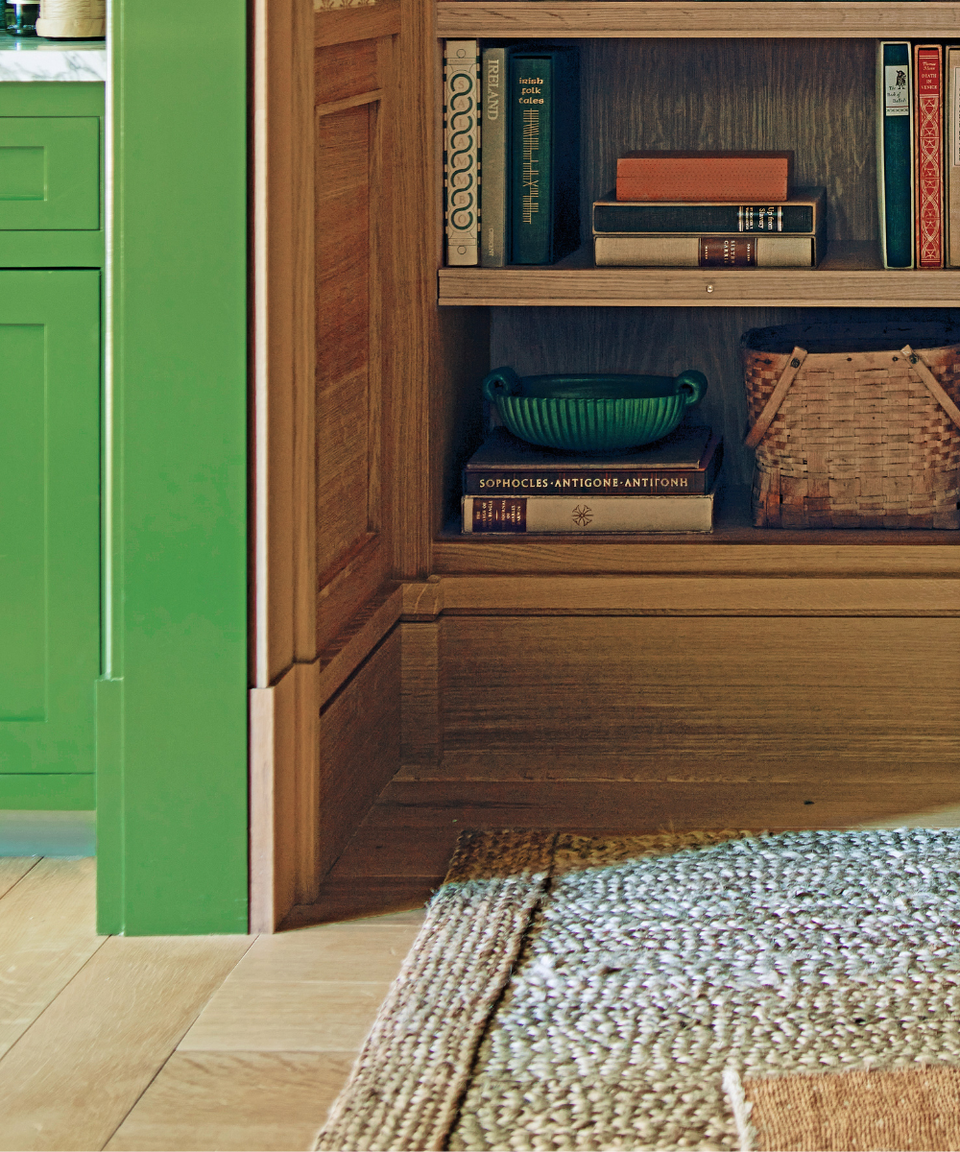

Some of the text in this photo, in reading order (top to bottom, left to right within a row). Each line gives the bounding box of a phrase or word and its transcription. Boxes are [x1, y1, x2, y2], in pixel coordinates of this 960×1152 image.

[519, 77, 544, 85] irish
[488, 60, 499, 121] IRELAND
[521, 86, 541, 95] folk
[767, 207, 774, 216] Up
[758, 208, 766, 229] Slavery
[479, 478, 548, 488] SOPHOCLES
[555, 478, 620, 488] ANTIGONE
